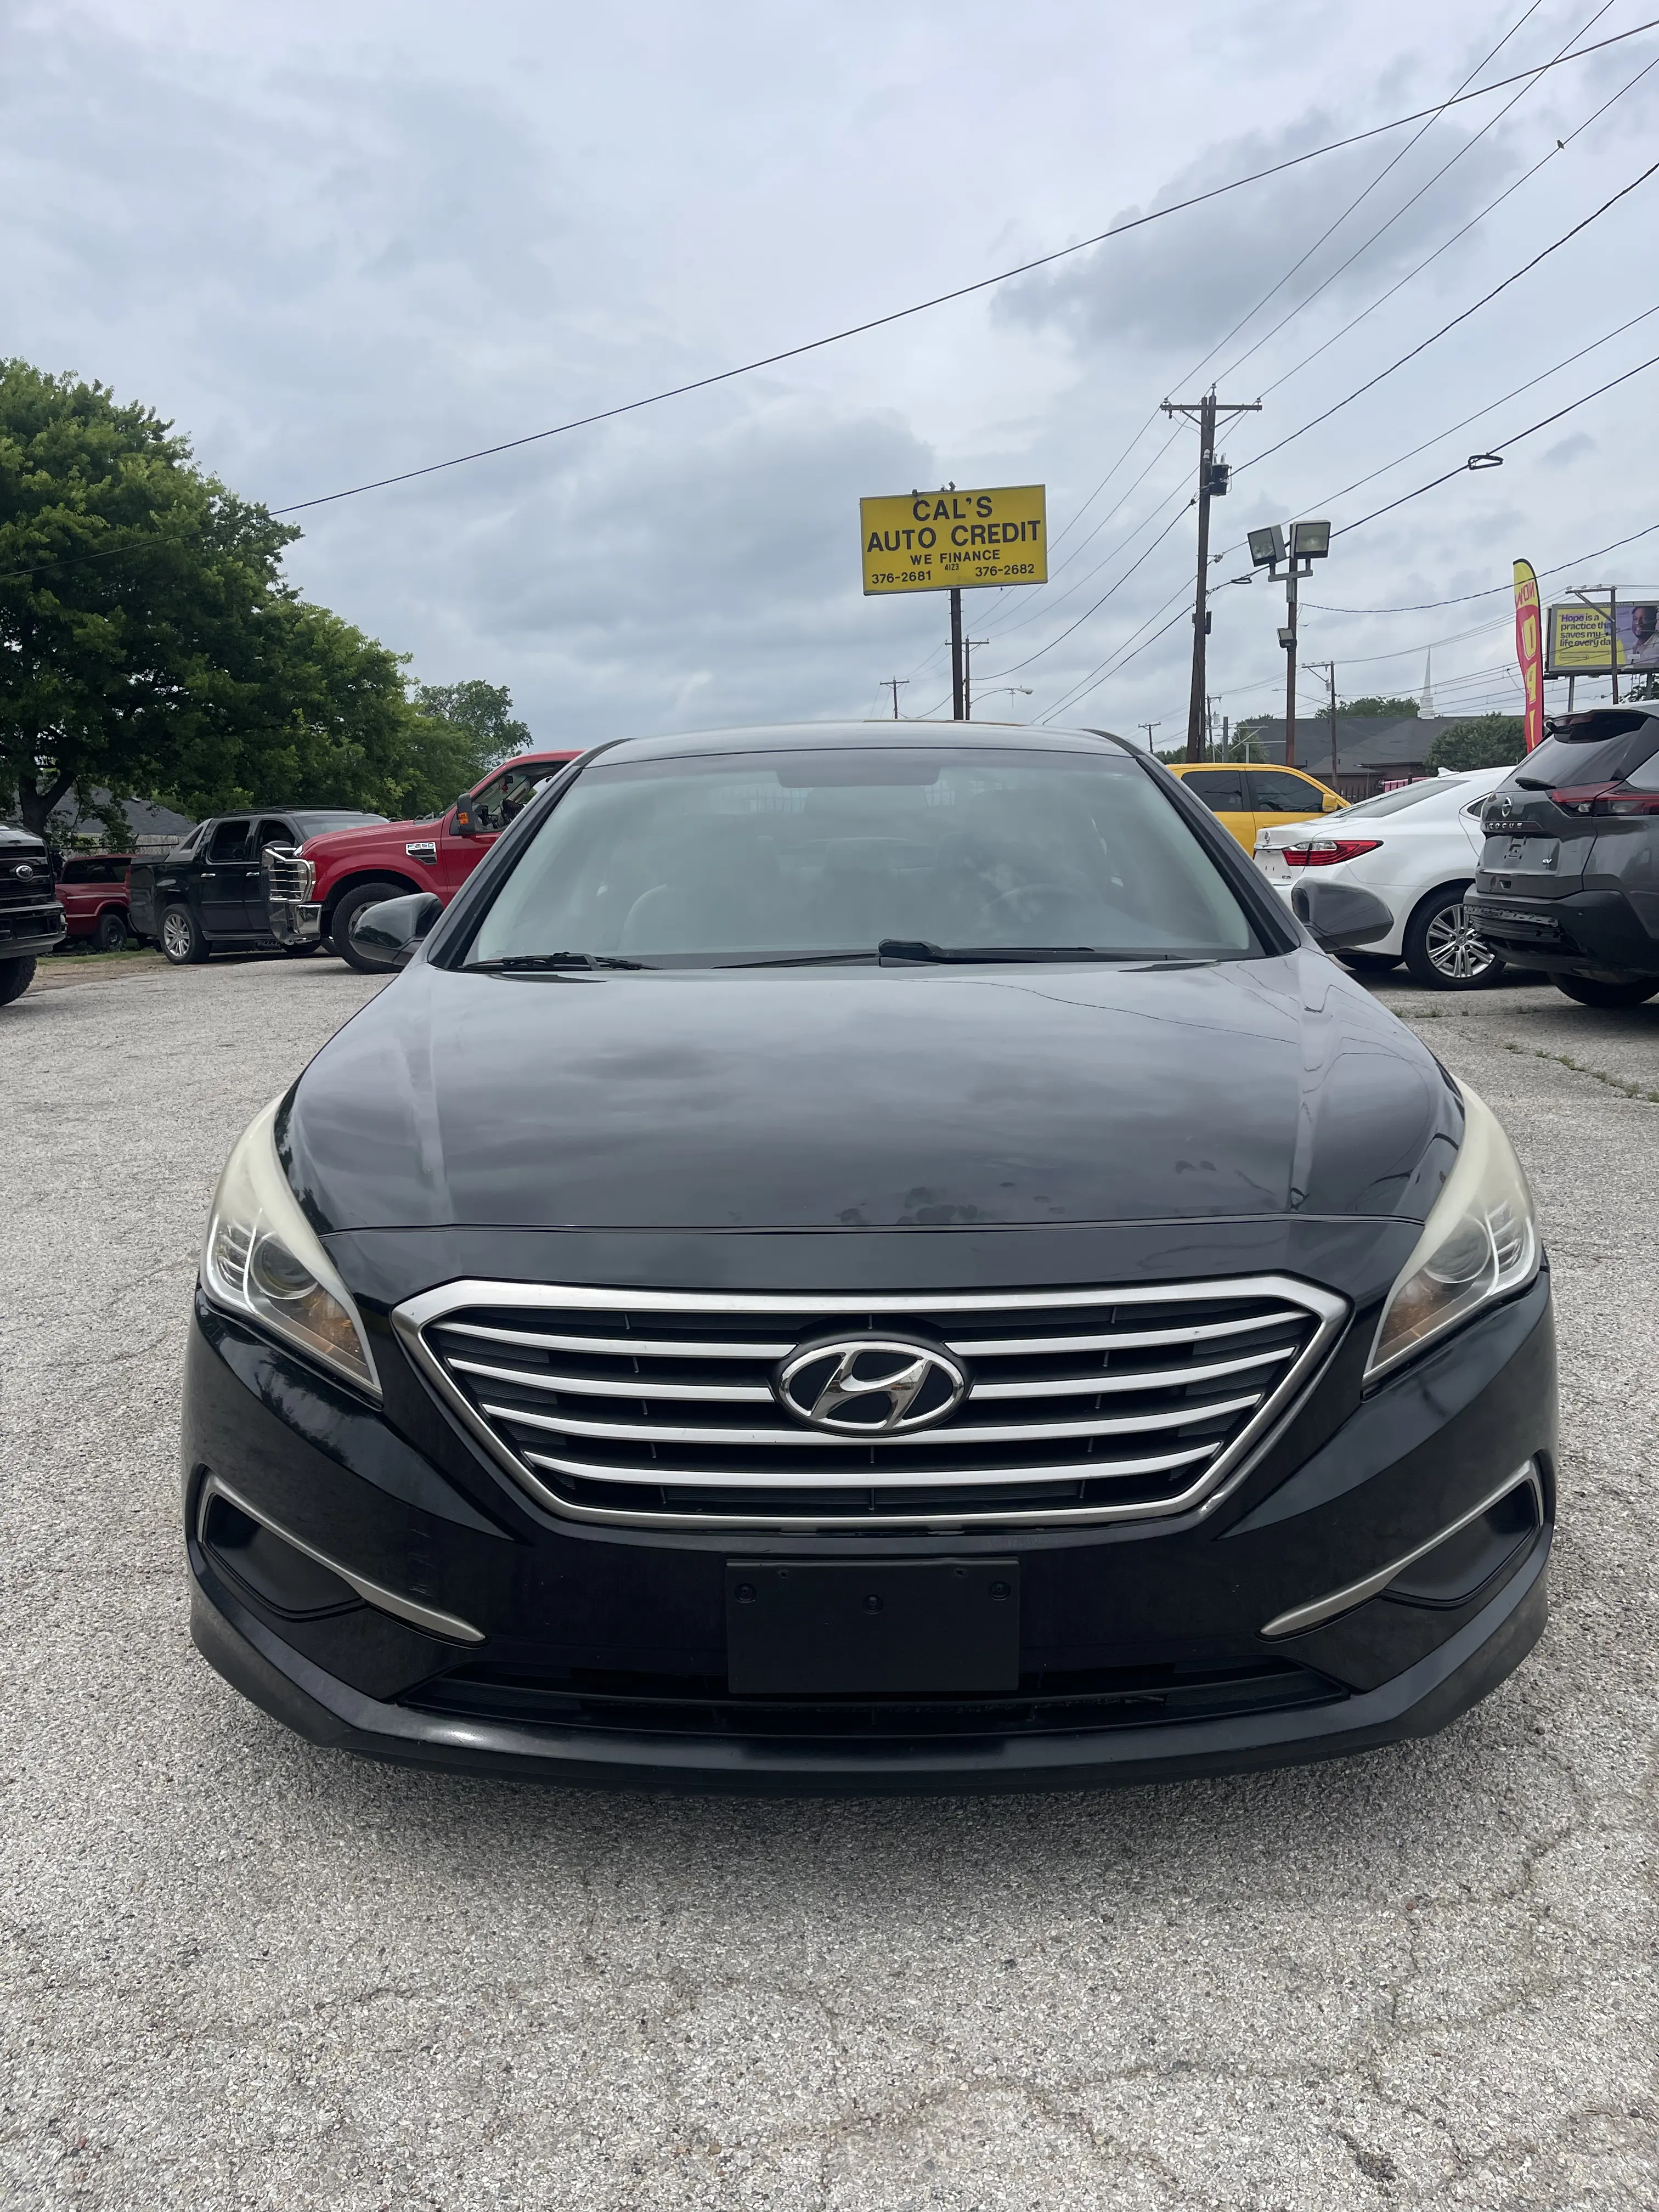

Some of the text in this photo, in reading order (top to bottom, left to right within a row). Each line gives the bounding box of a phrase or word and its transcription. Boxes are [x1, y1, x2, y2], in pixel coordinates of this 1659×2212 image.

[913, 496, 992, 521] CAL'S
[867, 520, 1041, 552] AUTO CREDIT
[910, 550, 1000, 565] WE FINANCE
[871, 563, 1035, 584] 376-2681 376-2682
[1585, 613, 1593, 621] is
[1561, 622, 1596, 631] practice
[1560, 639, 1573, 647] life
